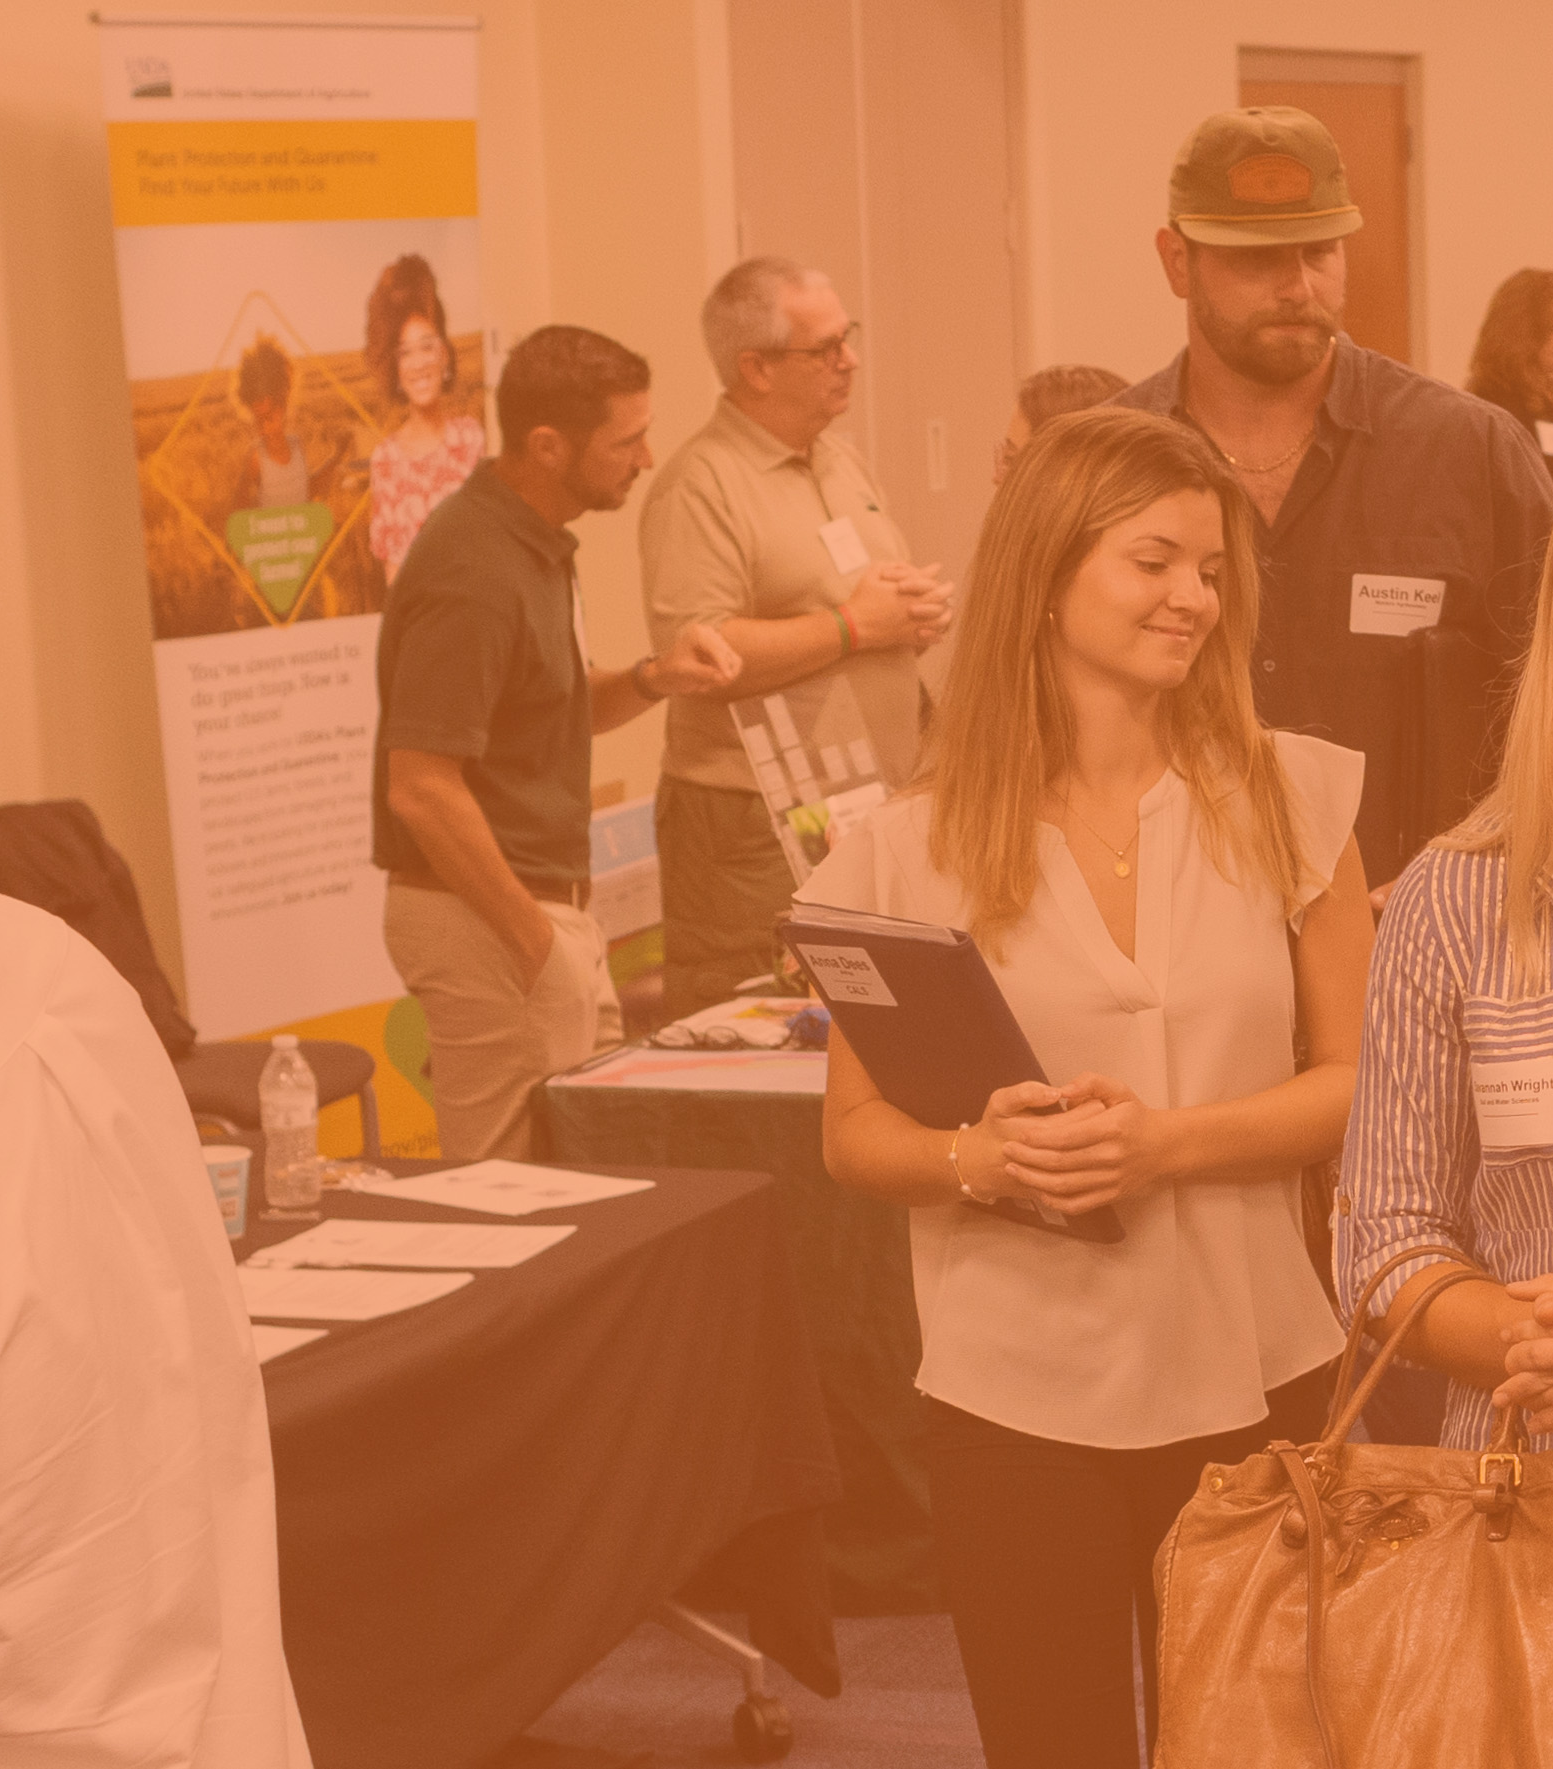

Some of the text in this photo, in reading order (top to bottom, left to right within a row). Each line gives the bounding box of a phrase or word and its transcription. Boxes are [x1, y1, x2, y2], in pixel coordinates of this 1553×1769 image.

[1358, 585, 1409, 602] Austin
[838, 956, 871, 971] Dees
[1510, 1077, 1553, 1093] Wright
